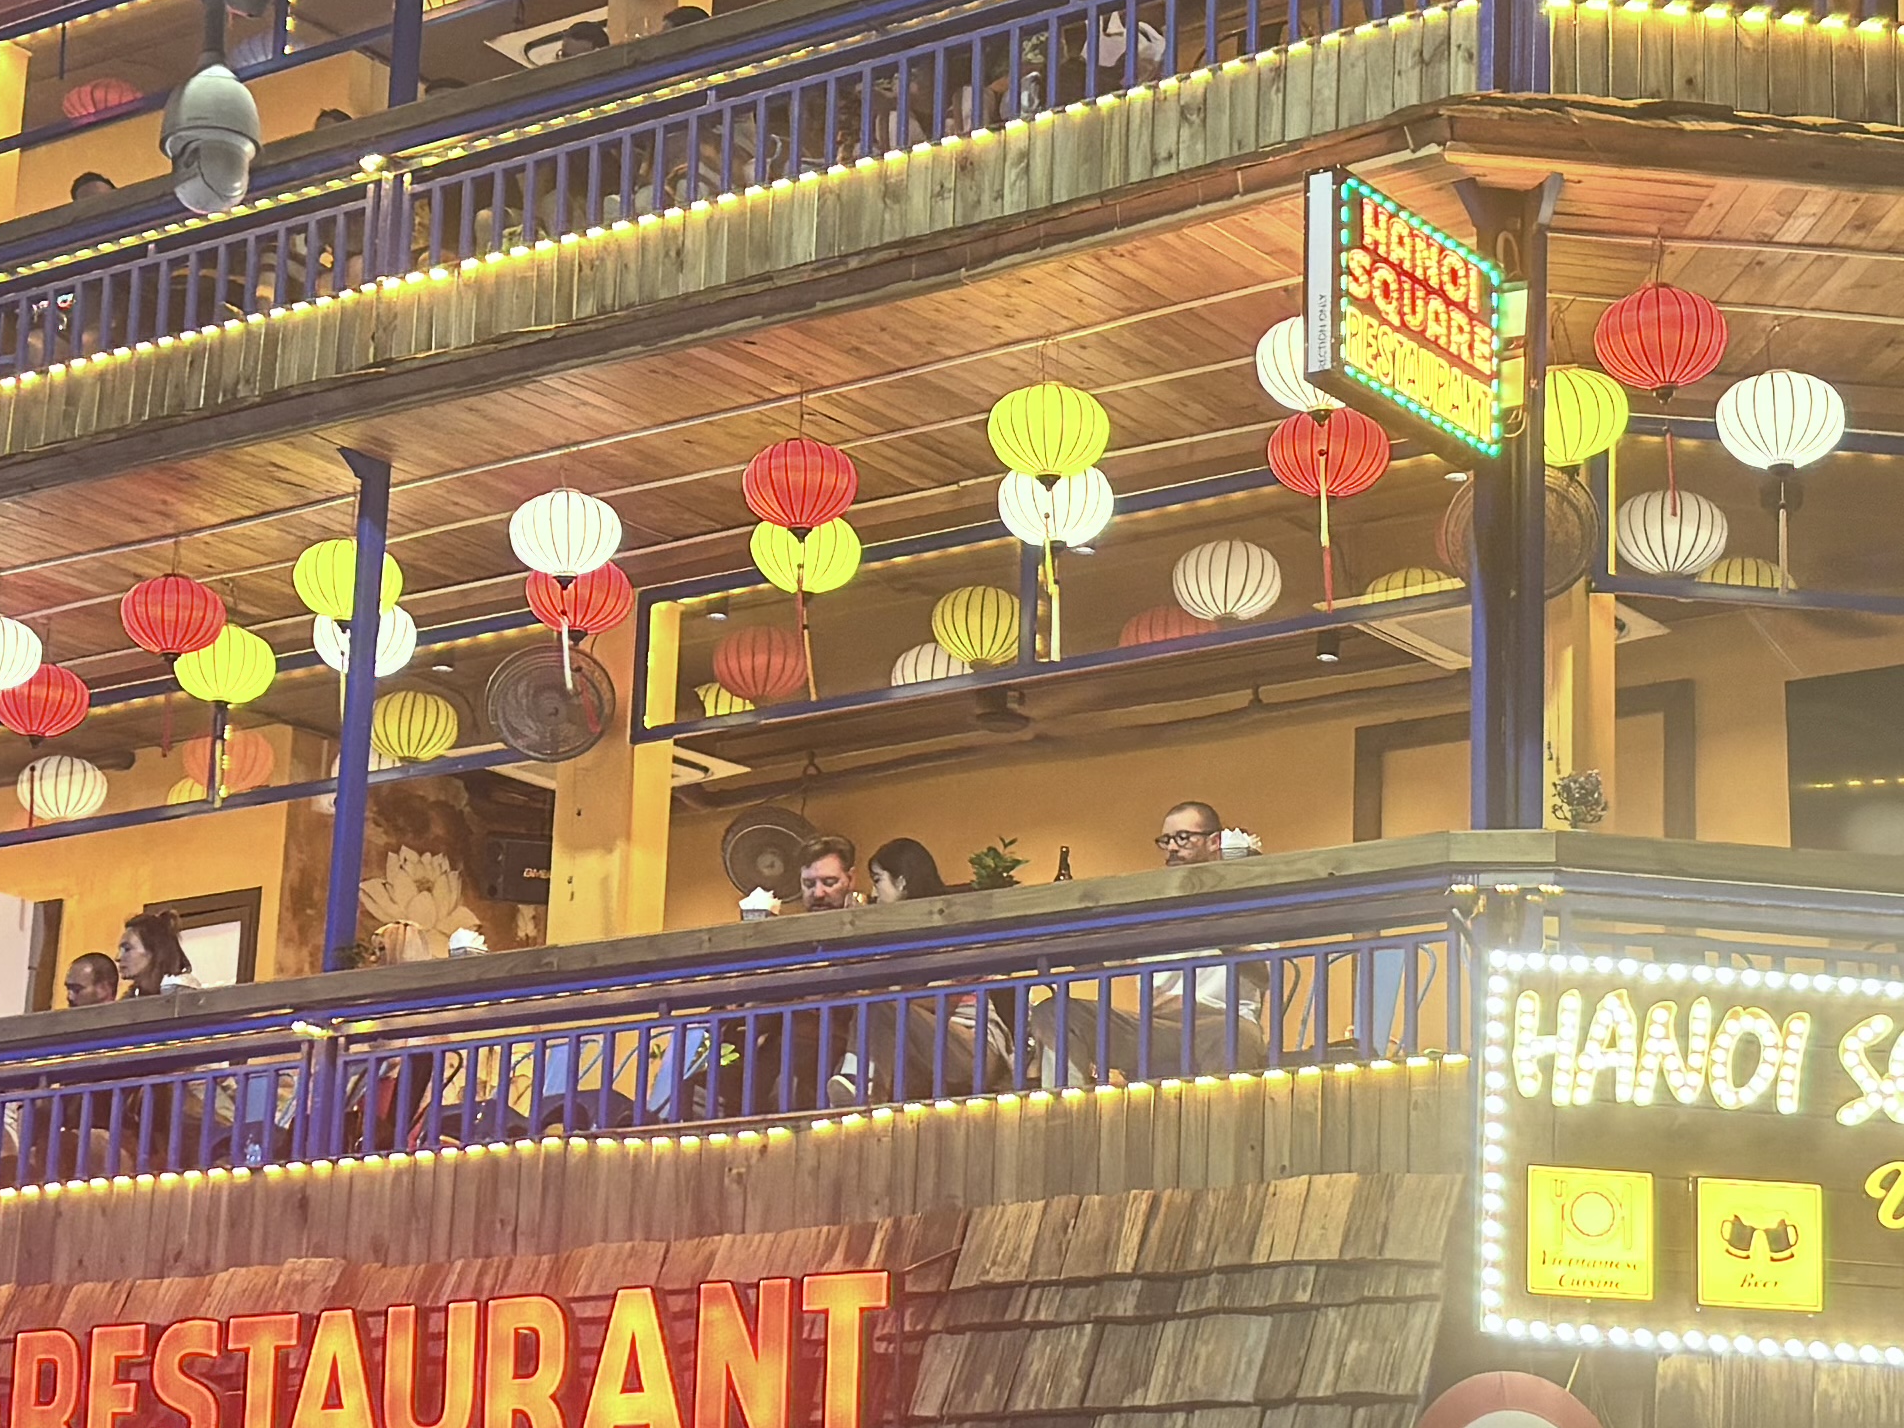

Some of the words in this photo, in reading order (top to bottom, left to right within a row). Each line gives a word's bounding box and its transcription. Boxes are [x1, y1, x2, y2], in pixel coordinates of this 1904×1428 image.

[1347, 247, 1492, 376] SQUARE
[1363, 197, 1481, 314] HANOI
[1345, 305, 1494, 442] RESTAURANT
[1513, 988, 1812, 1115] HANOI
[1558, 1273, 1621, 1290] Cuisine
[1739, 1272, 1779, 1289] Beer
